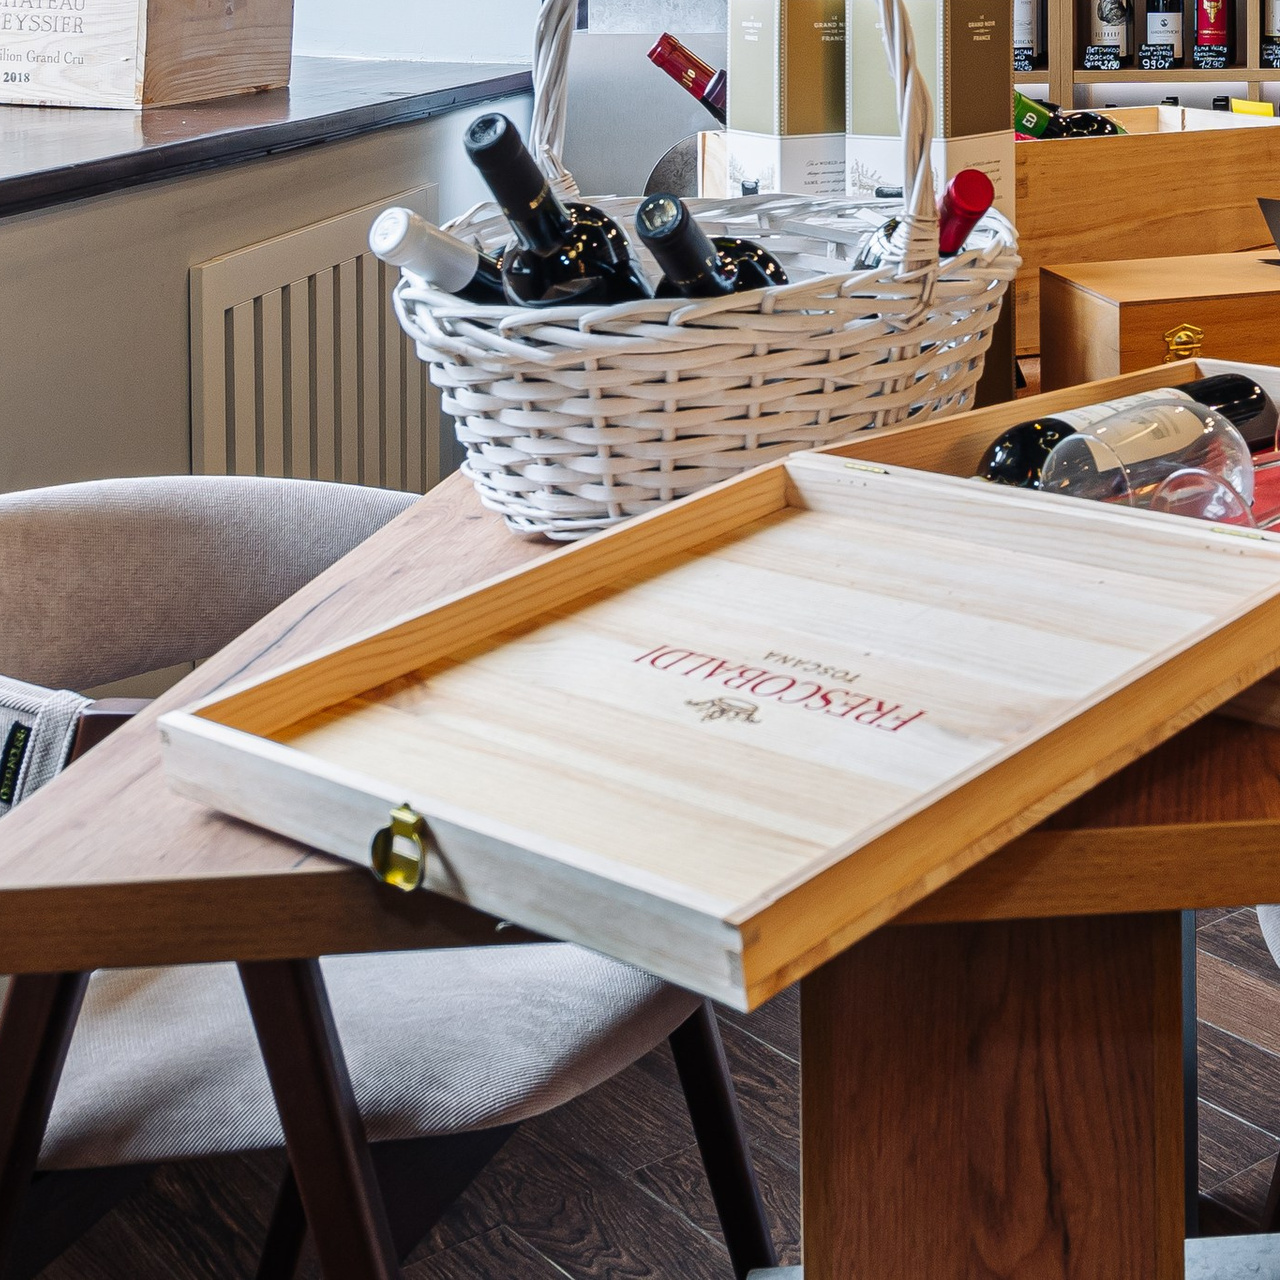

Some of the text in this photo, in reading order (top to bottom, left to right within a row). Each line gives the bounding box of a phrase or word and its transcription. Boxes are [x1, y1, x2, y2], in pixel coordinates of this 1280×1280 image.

[27, 50, 60, 63] Grand
[64, 52, 84, 64] Cru
[1199, 61, 1224, 69] 1290
[3, 72, 30, 82] 2018
[762, 649, 862, 684] TOSCANA
[633, 644, 928, 733] FRESCOBALDI
